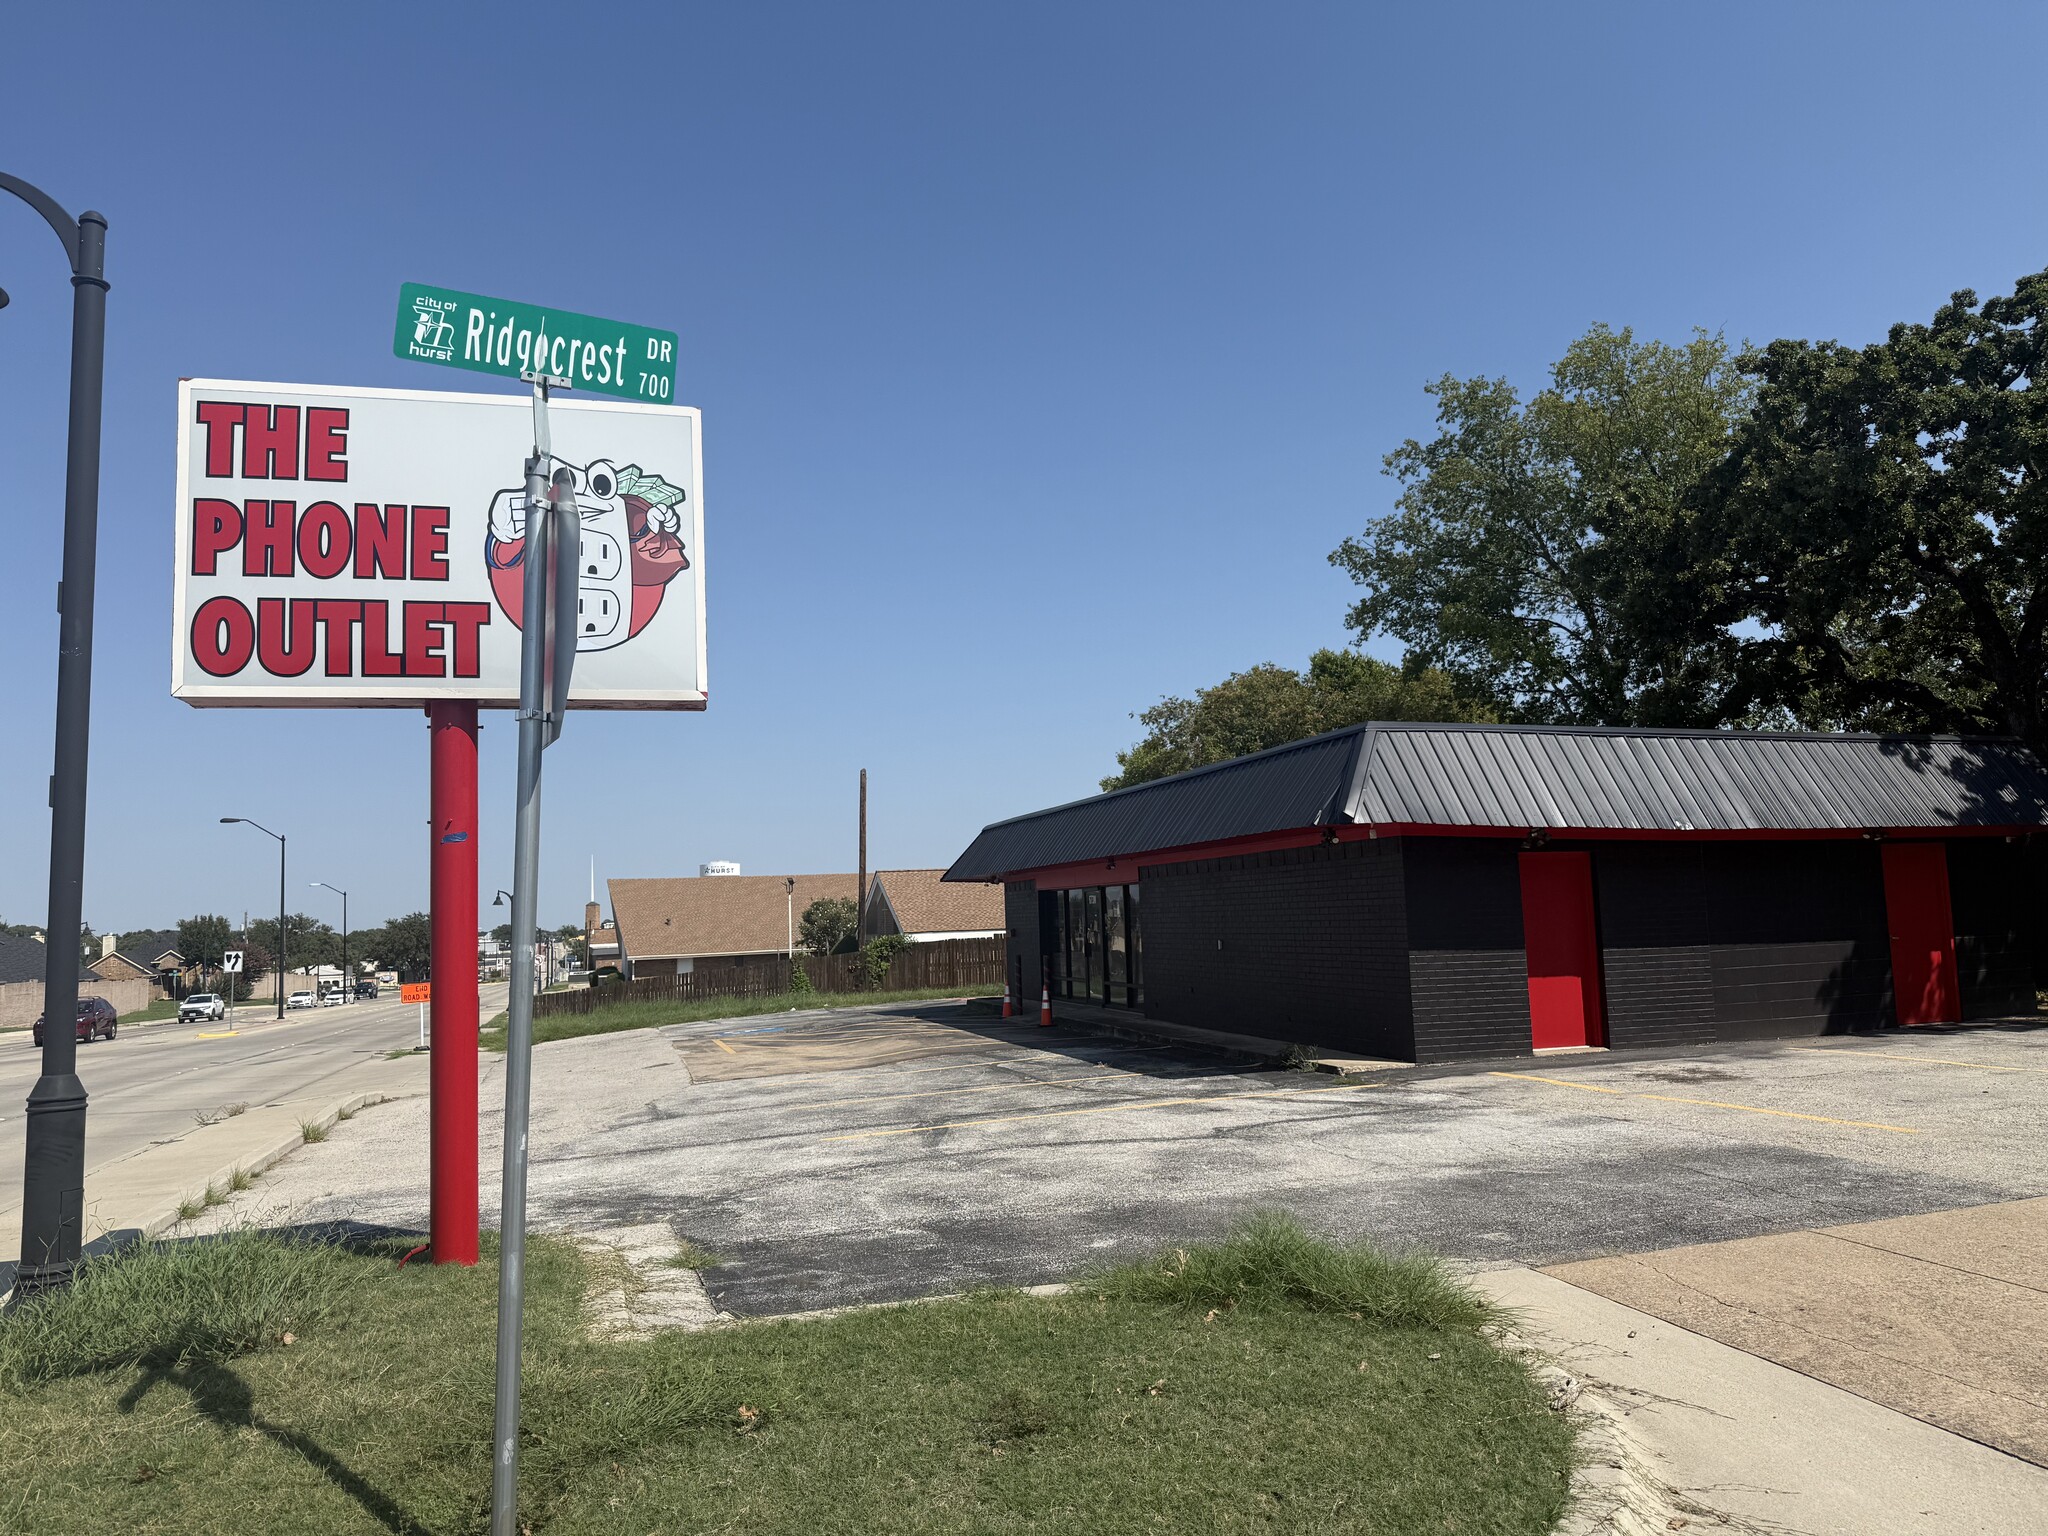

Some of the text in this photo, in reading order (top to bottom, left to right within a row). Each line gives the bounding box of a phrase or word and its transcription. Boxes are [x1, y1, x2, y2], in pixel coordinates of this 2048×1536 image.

[416, 296, 457, 312] city of
[409, 341, 453, 362] hurst
[647, 337, 672, 363] DR
[639, 372, 669, 398] 700
[196, 400, 350, 482] THE
[191, 498, 450, 581] PHONE
[190, 595, 491, 679] OUTLET
